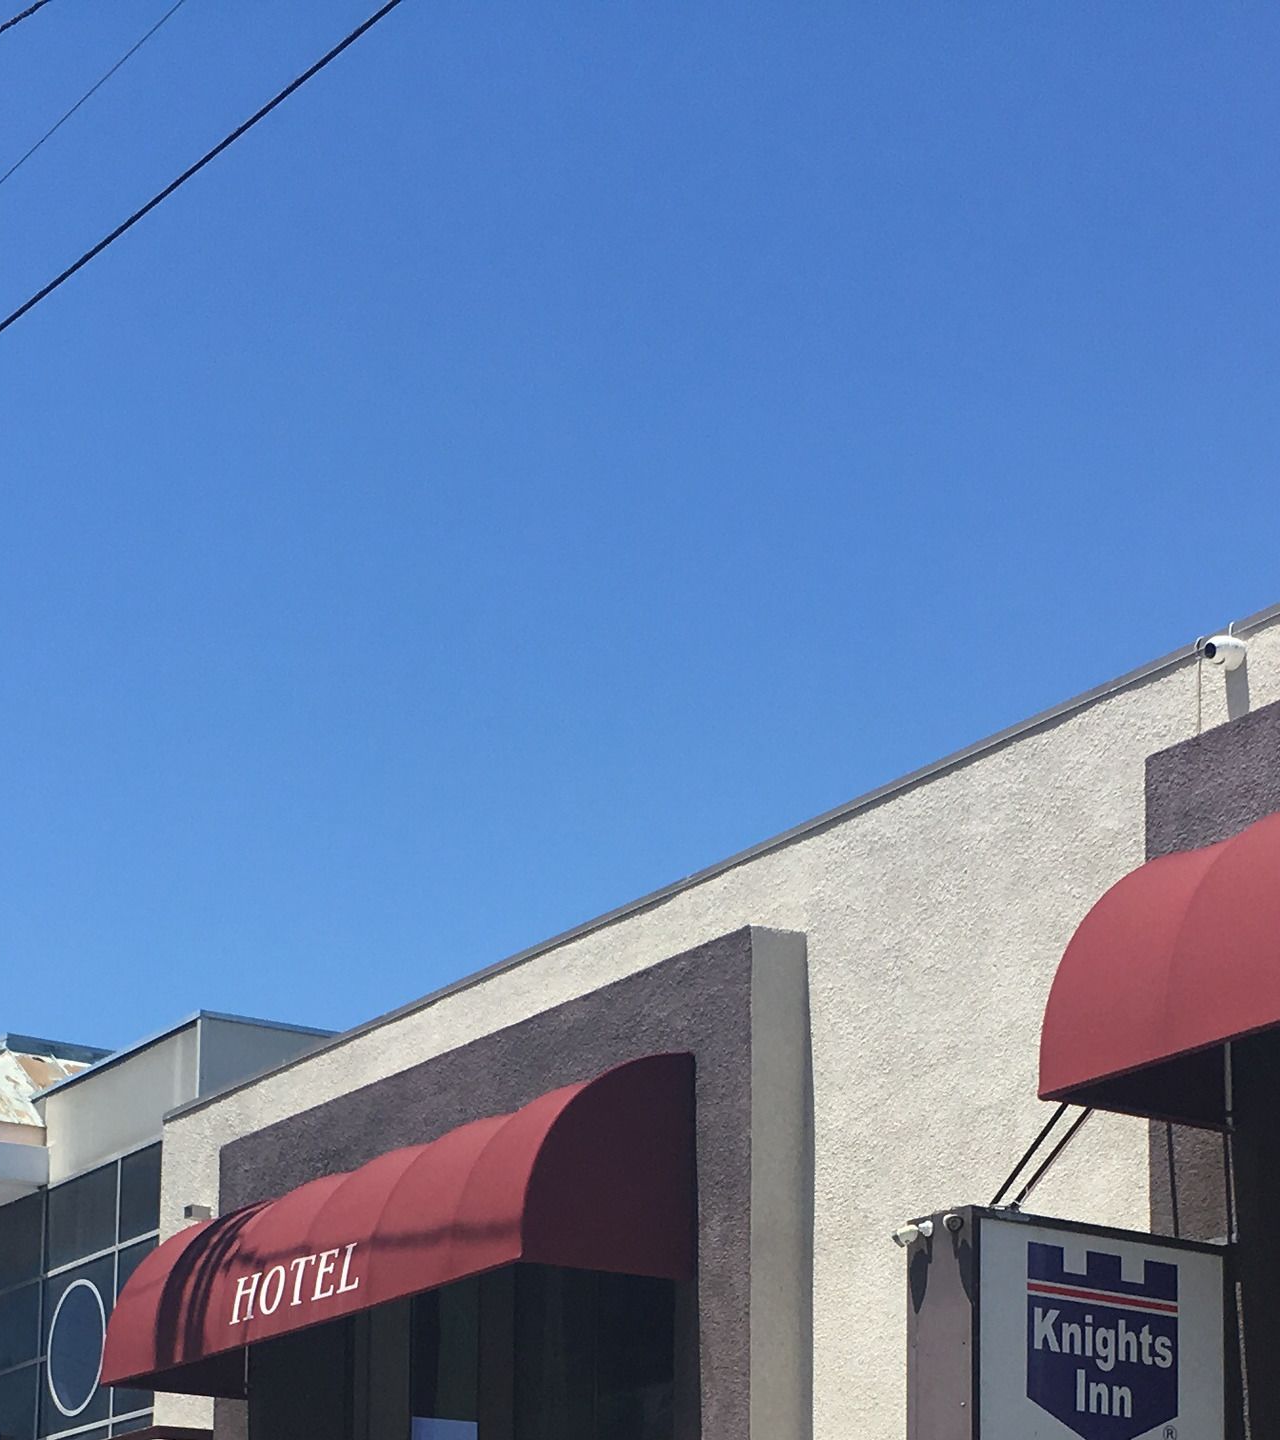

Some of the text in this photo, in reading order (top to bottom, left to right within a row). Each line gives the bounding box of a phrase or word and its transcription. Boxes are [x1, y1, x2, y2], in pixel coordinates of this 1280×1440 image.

[229, 1241, 360, 1325] HOTEL
[1033, 1306, 1173, 1372] Knights
[1076, 1368, 1132, 1419] Inn
